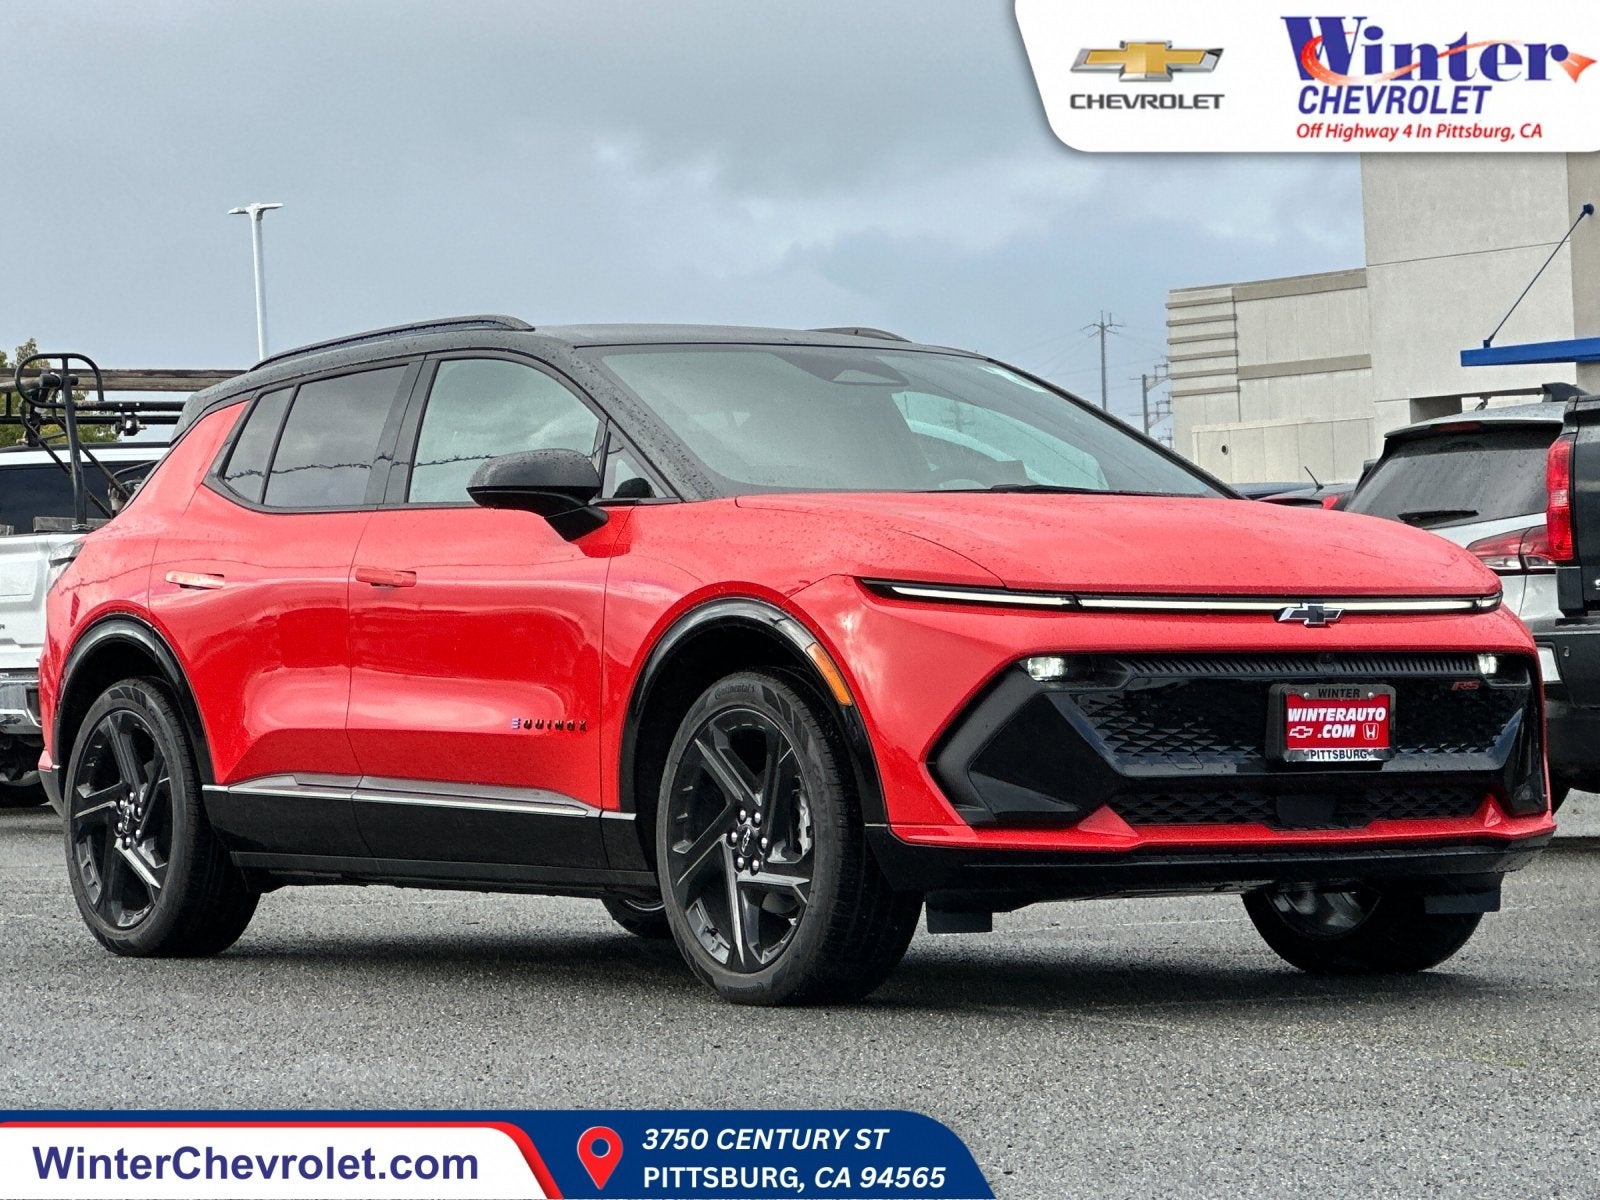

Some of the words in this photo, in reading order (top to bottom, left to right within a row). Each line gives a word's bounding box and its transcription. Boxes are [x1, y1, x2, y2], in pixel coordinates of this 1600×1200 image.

[1318, 688, 1360, 699] WINTER
[1287, 707, 1386, 722] WINTERAUTO
[1317, 724, 1356, 739] .COM
[1310, 749, 1367, 760] PITTSBURG
